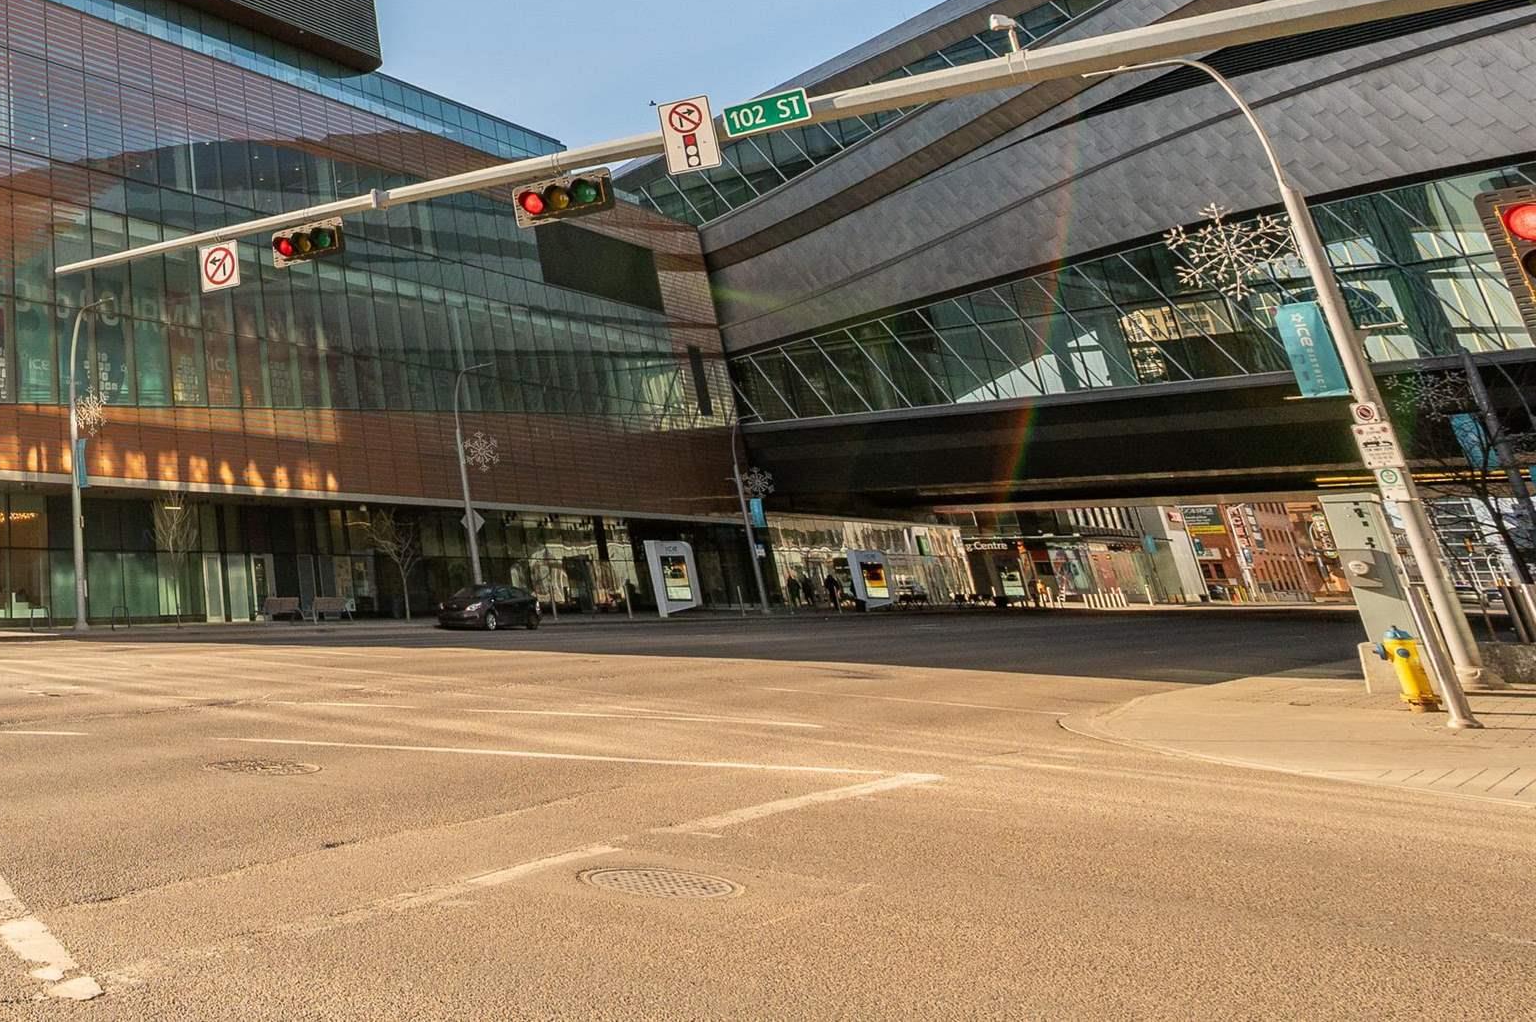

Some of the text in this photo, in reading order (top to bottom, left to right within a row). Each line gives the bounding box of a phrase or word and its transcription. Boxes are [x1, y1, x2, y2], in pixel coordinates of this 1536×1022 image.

[729, 95, 801, 130] 102 ST
[1294, 322, 1314, 348] ICE
[974, 540, 1009, 551] Centre
